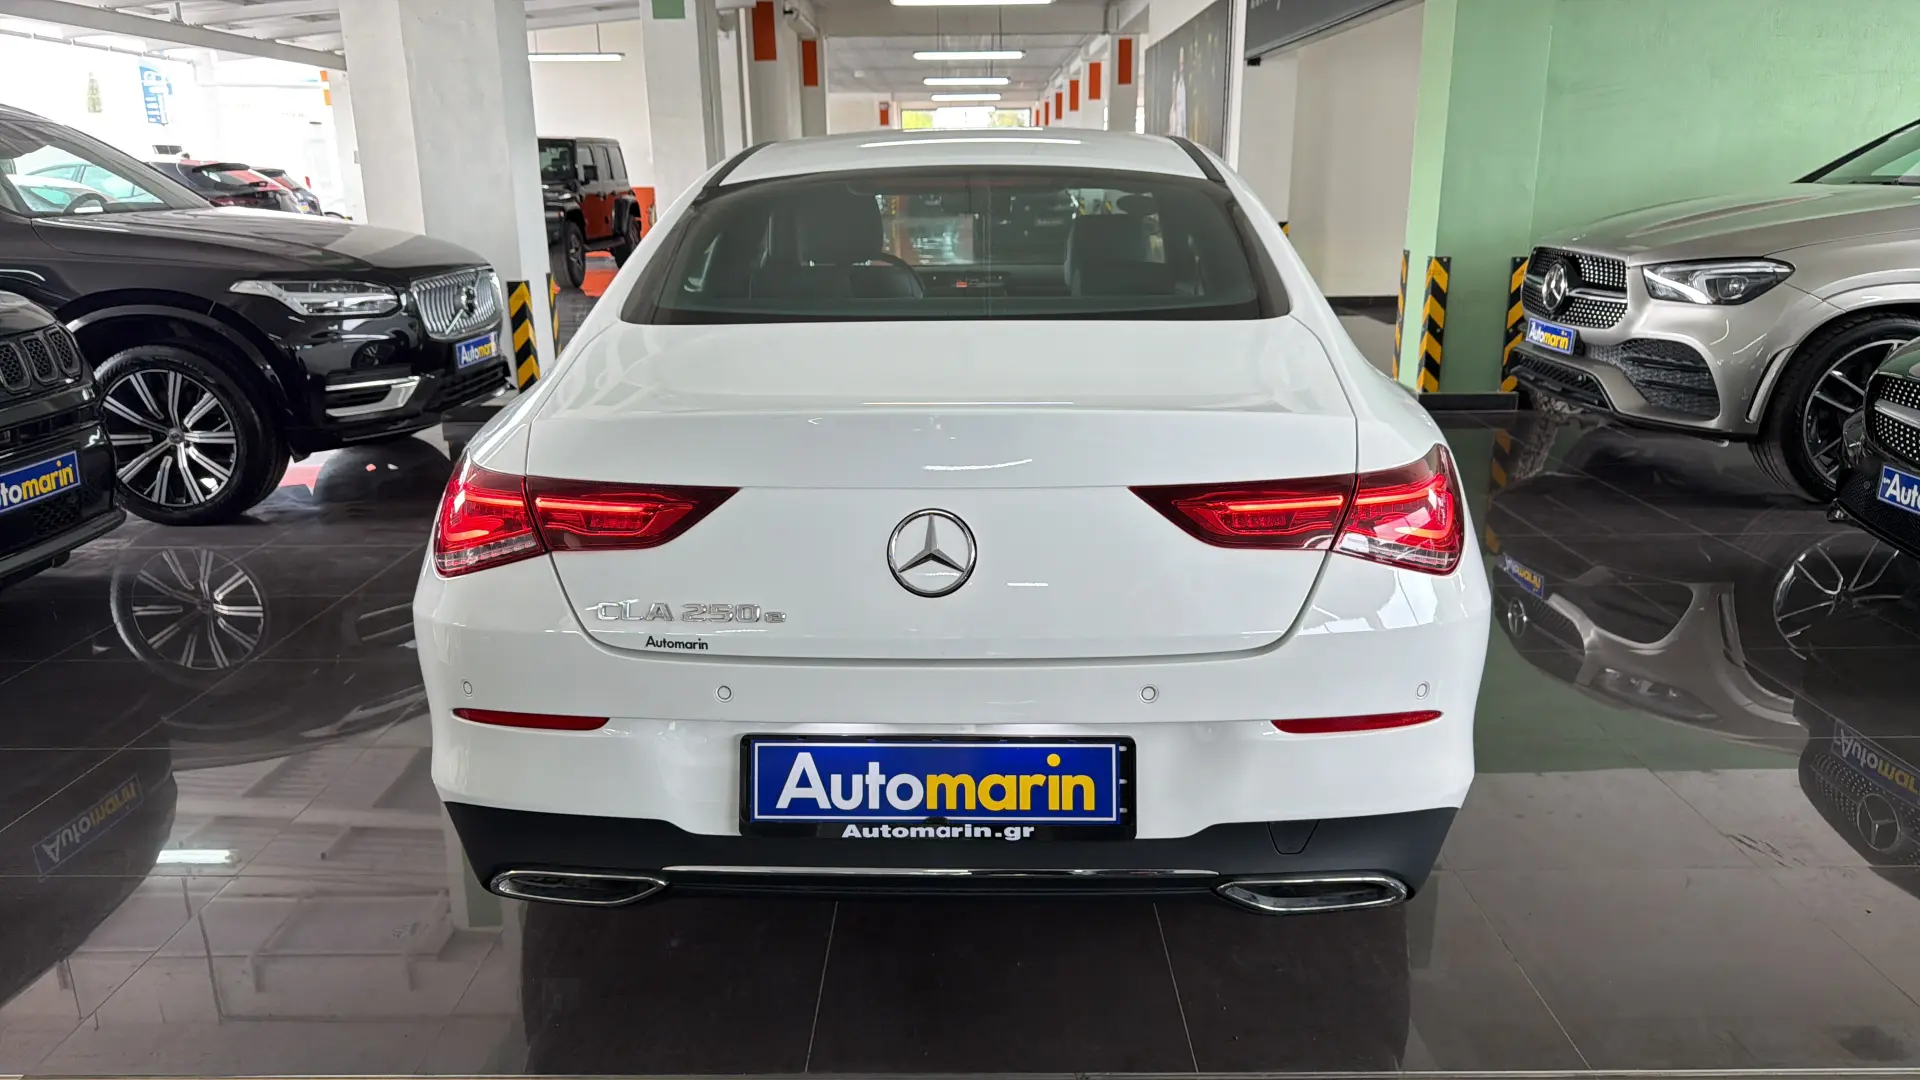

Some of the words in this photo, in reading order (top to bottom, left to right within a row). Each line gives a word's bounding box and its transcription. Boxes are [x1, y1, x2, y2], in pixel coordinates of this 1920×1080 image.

[1529, 321, 1569, 350] Automarin
[461, 341, 496, 364] Automar
[0, 460, 74, 507] tomarin
[596, 602, 675, 621] CLA
[645, 636, 709, 650] Automarin
[775, 752, 1096, 811] Automarin
[842, 824, 1035, 841] Automarin.gr
